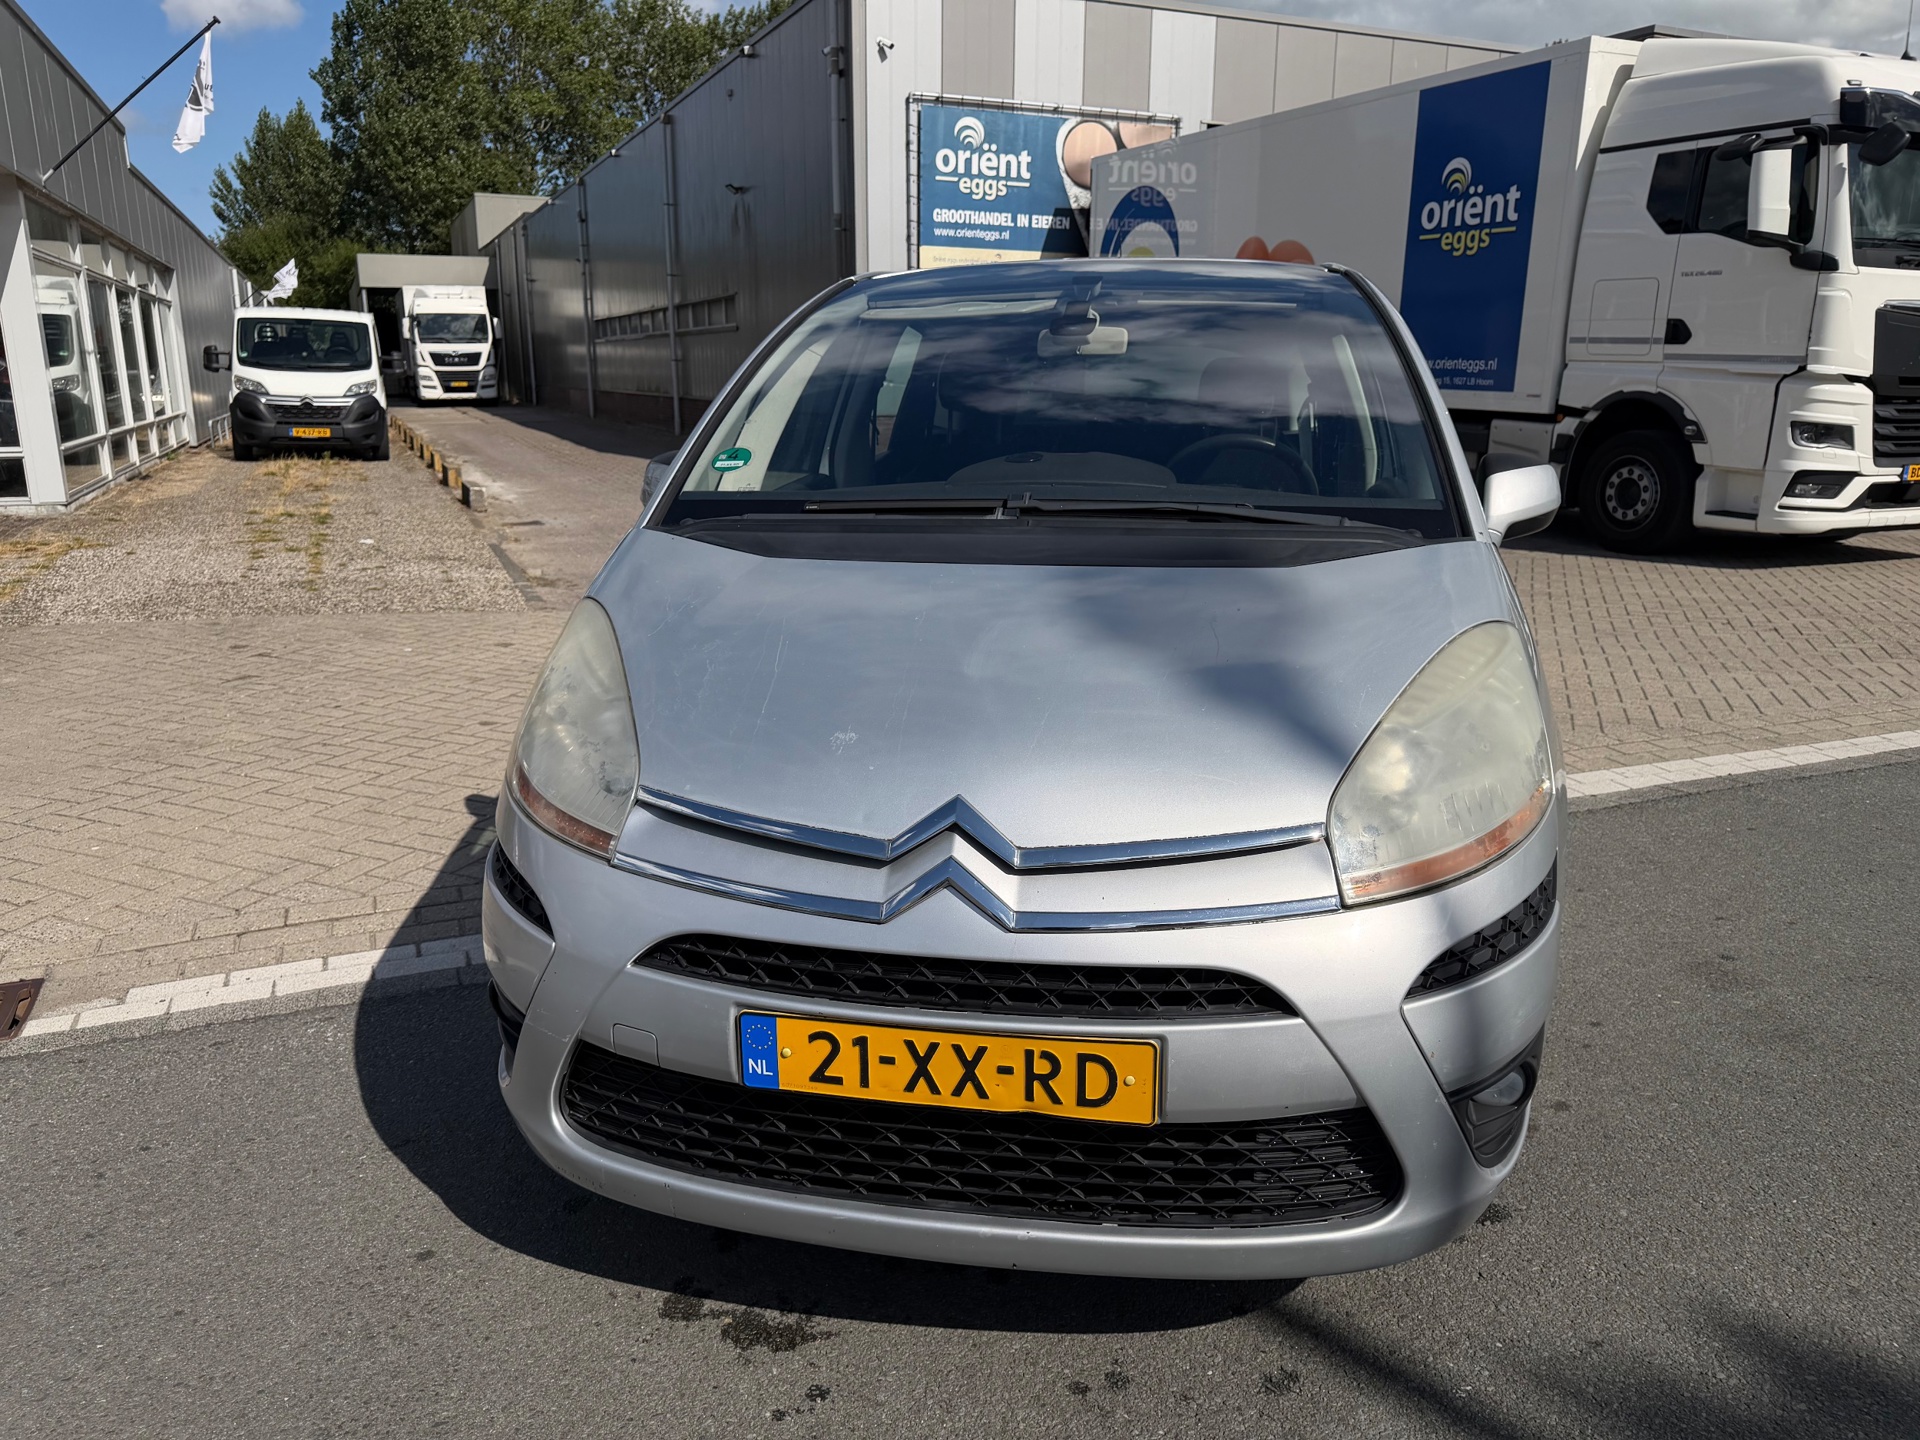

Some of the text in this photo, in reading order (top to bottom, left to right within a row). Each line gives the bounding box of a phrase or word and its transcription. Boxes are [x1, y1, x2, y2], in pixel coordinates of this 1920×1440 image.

[935, 143, 1032, 179] oriënt
[959, 177, 1007, 200] eggs
[933, 208, 1070, 230] GROOTHANDEL IN EIEREN
[1421, 184, 1521, 230] oriënt
[934, 227, 1010, 241] www.orienteggs.nl
[1441, 228, 1490, 256] eggs
[748, 1030, 1118, 1108] NL 21-XX-RD
